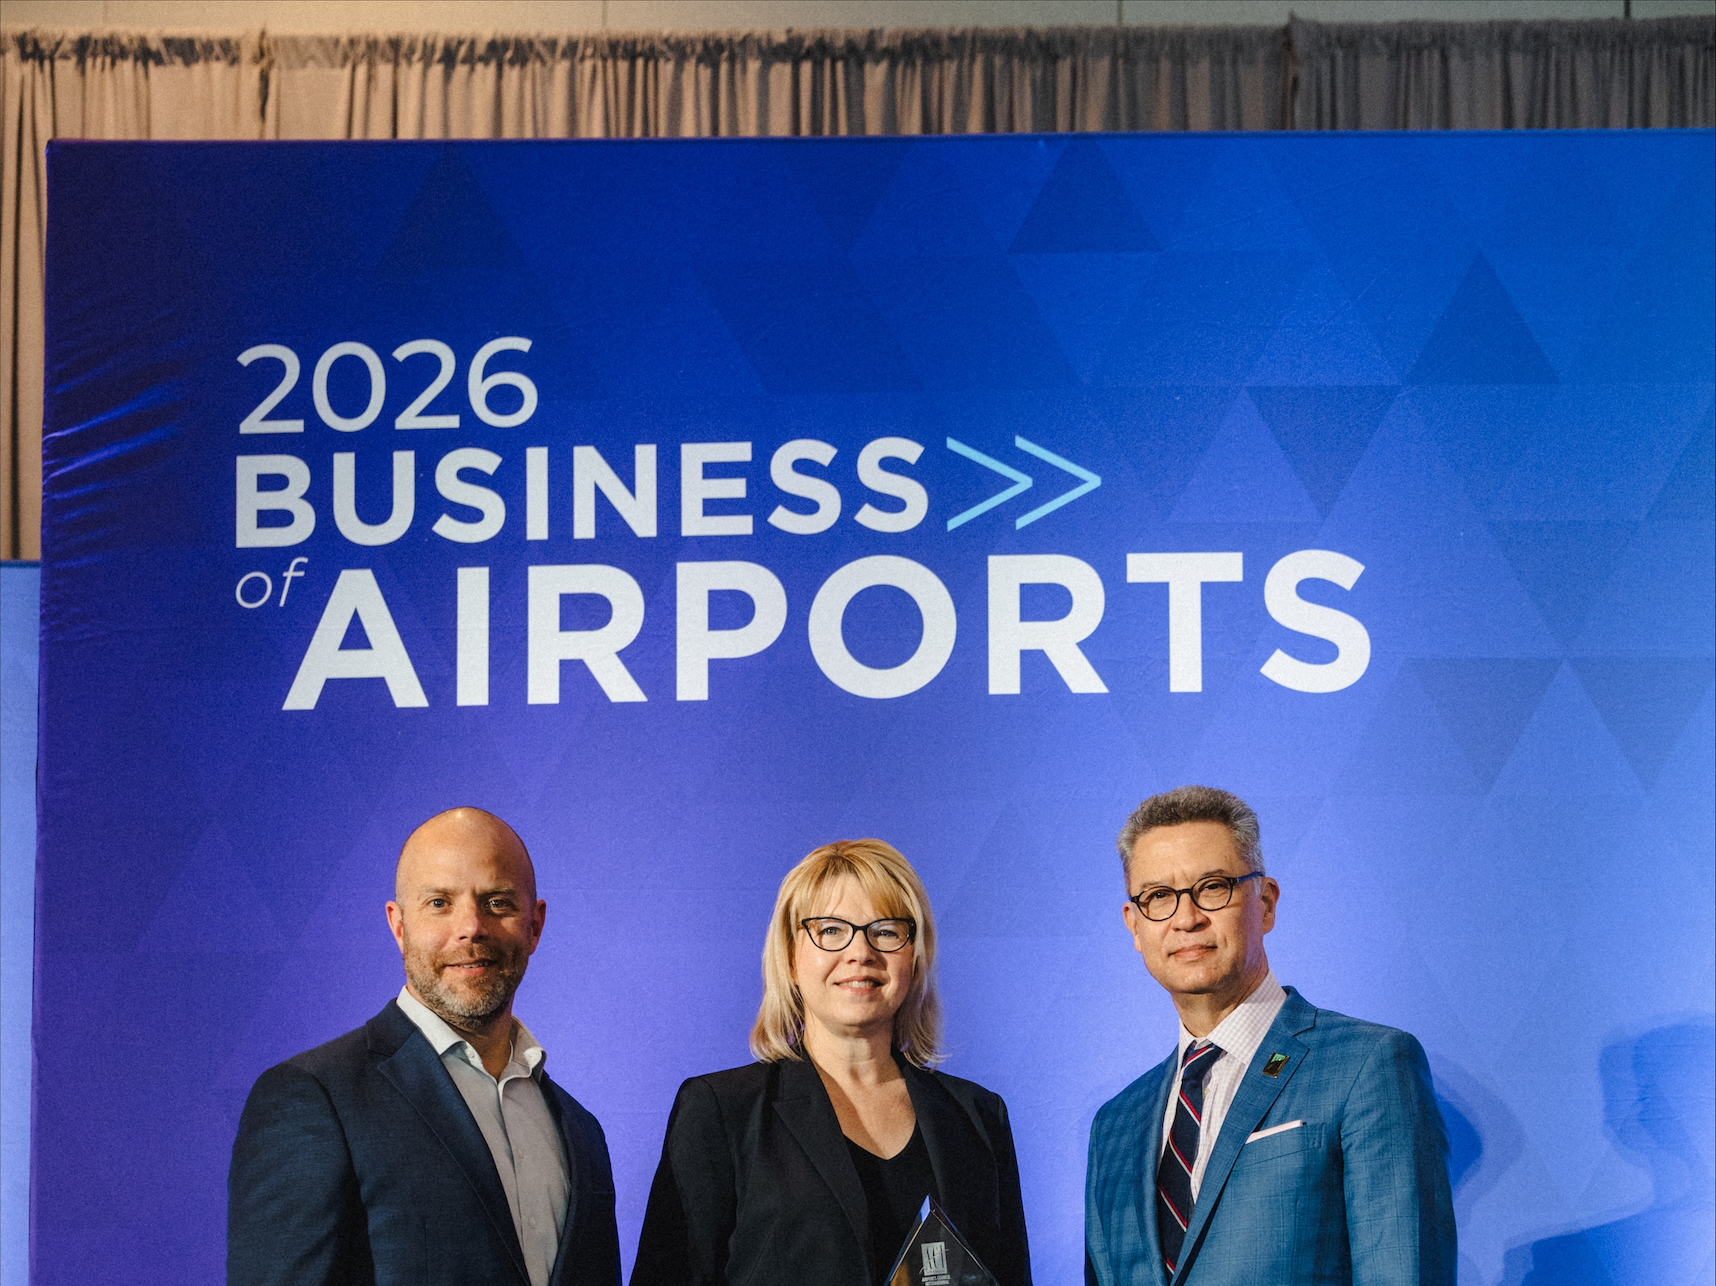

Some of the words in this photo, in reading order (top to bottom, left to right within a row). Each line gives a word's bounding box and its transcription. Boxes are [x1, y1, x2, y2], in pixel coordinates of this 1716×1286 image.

[237, 337, 538, 433] 2026
[236, 438, 929, 548] BUSINESS
[236, 558, 309, 609] of
[283, 550, 1372, 711] AIRPORTS
